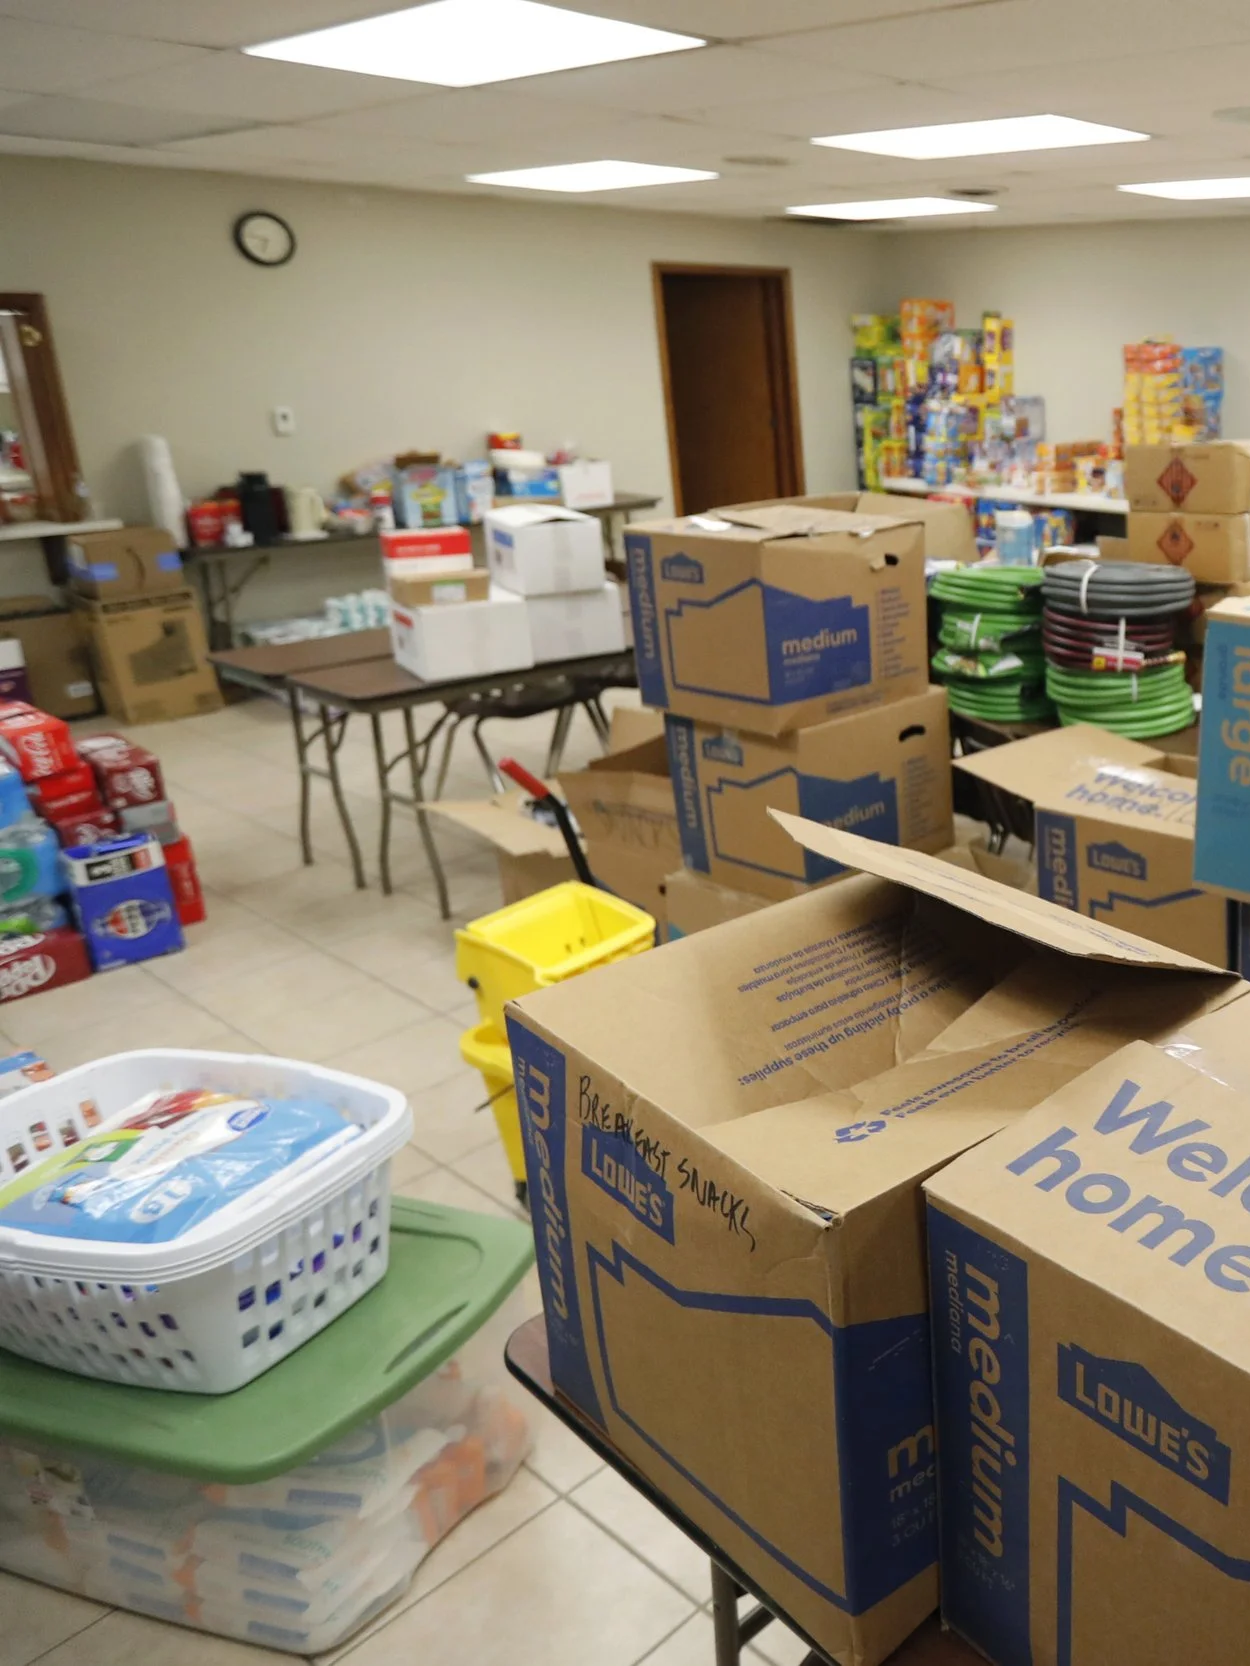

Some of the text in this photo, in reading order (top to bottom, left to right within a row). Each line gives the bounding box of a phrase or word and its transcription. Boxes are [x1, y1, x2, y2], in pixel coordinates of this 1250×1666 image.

[781, 627, 858, 656] medium
[1051, 828, 1074, 907] medi
[1093, 850, 1142, 876] LOWE'S
[794, 1042, 830, 1062] these
[828, 1032, 846, 1047] up
[844, 1013, 888, 1040] picking
[737, 1056, 795, 1087] supplies:
[528, 1063, 569, 1321] medium
[591, 1137, 666, 1228] LOWE'S
[677, 1157, 757, 1253] SNACKS
[944, 1249, 965, 1355] mediana
[965, 1261, 1017, 1558] medium
[1076, 1360, 1209, 1481] LOWE'S
